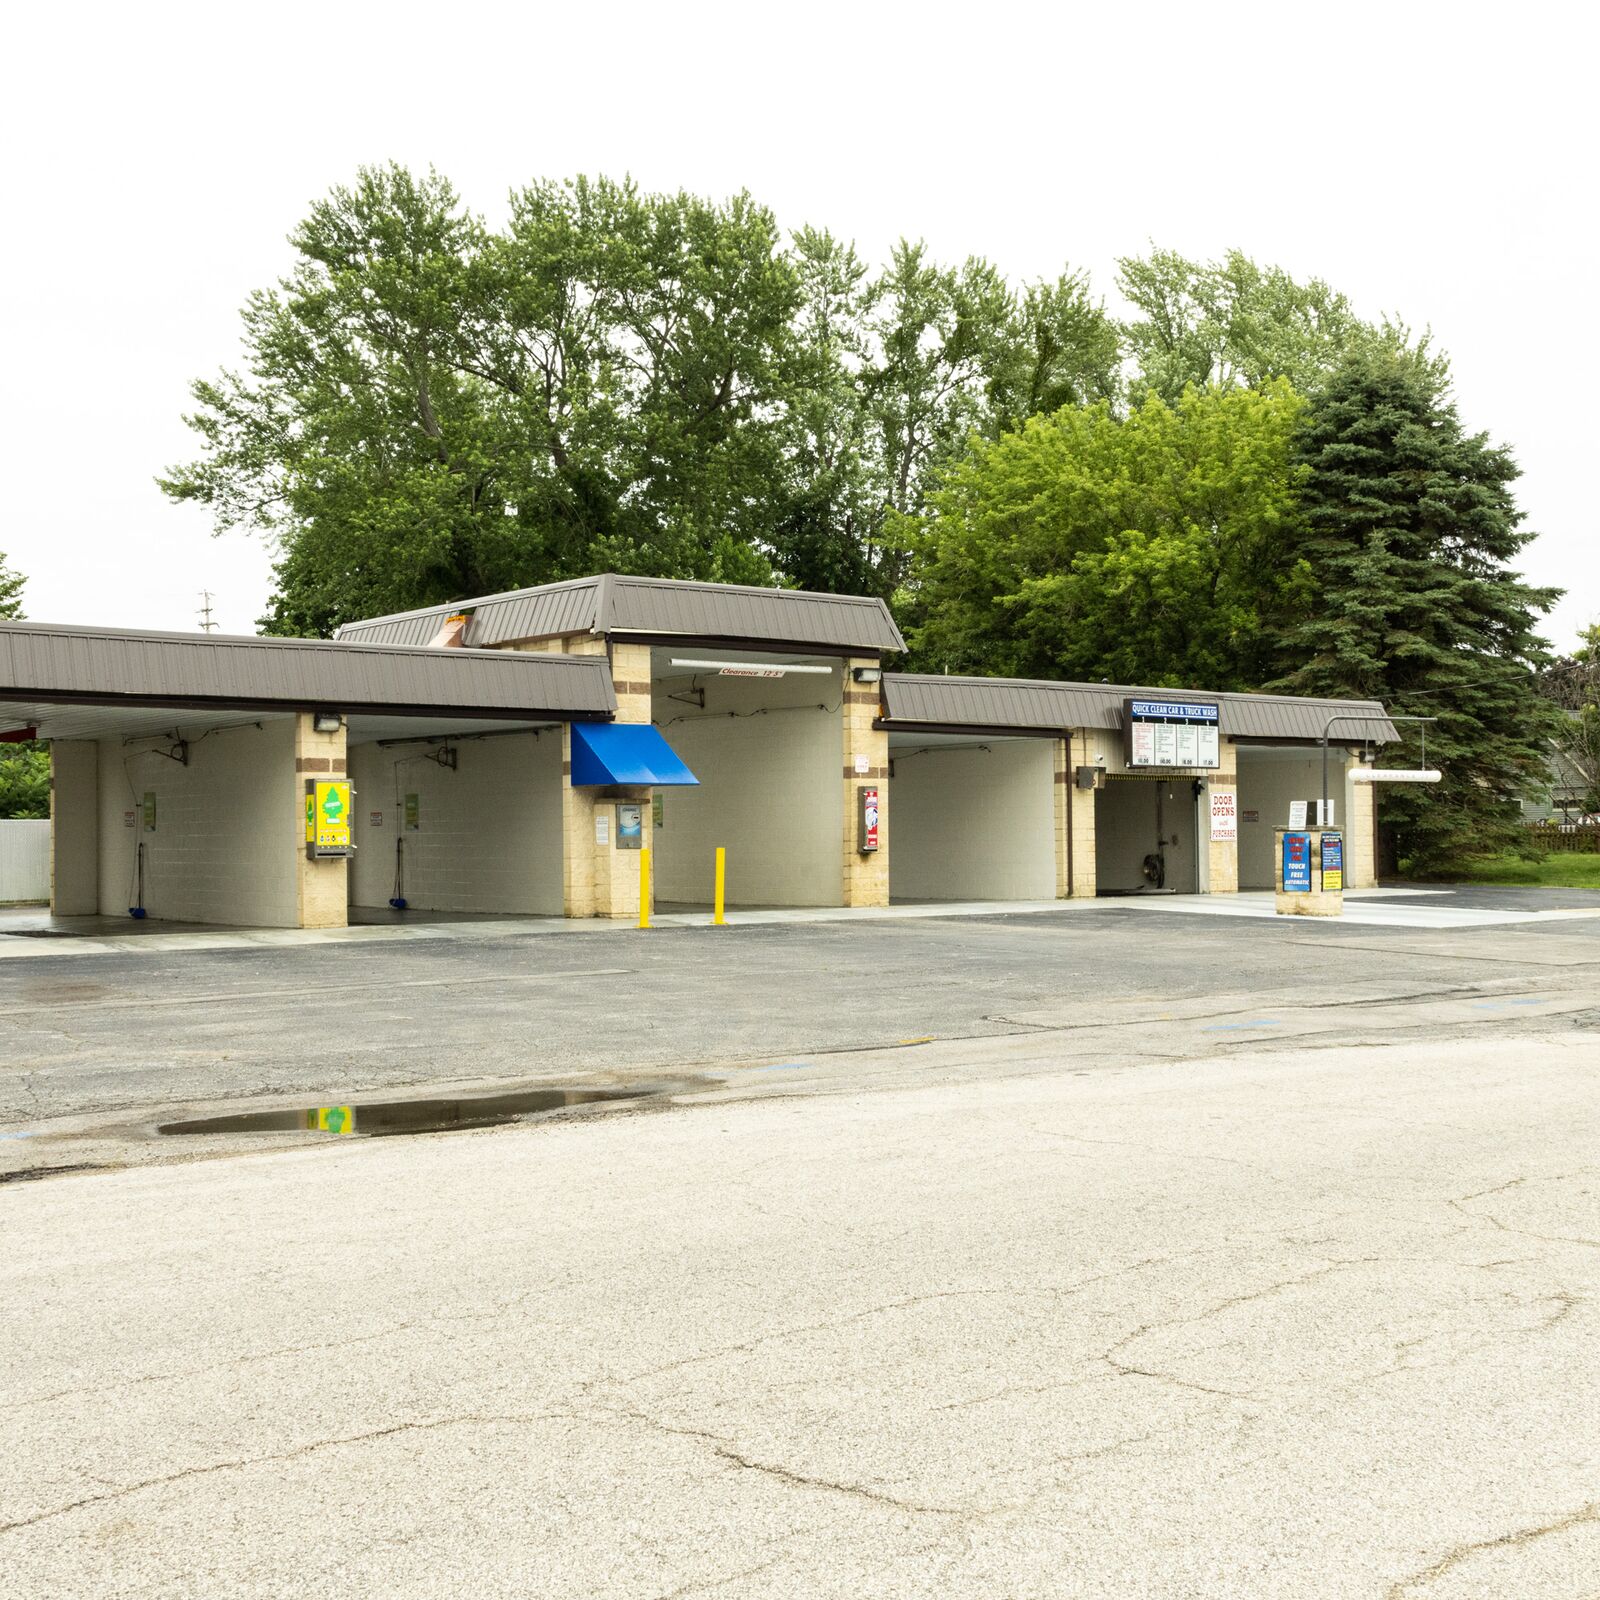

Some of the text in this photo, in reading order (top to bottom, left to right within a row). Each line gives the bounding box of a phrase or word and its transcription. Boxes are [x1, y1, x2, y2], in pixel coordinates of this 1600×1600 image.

[1132, 704, 1149, 713] QUICK
[1150, 705, 1168, 714] CLEAN
[1168, 706, 1179, 714] CAR
[1184, 708, 1202, 716] TRUCK
[1202, 708, 1218, 717] WASH
[1214, 796, 1232, 805] DOOR
[1212, 807, 1235, 816] OPENS
